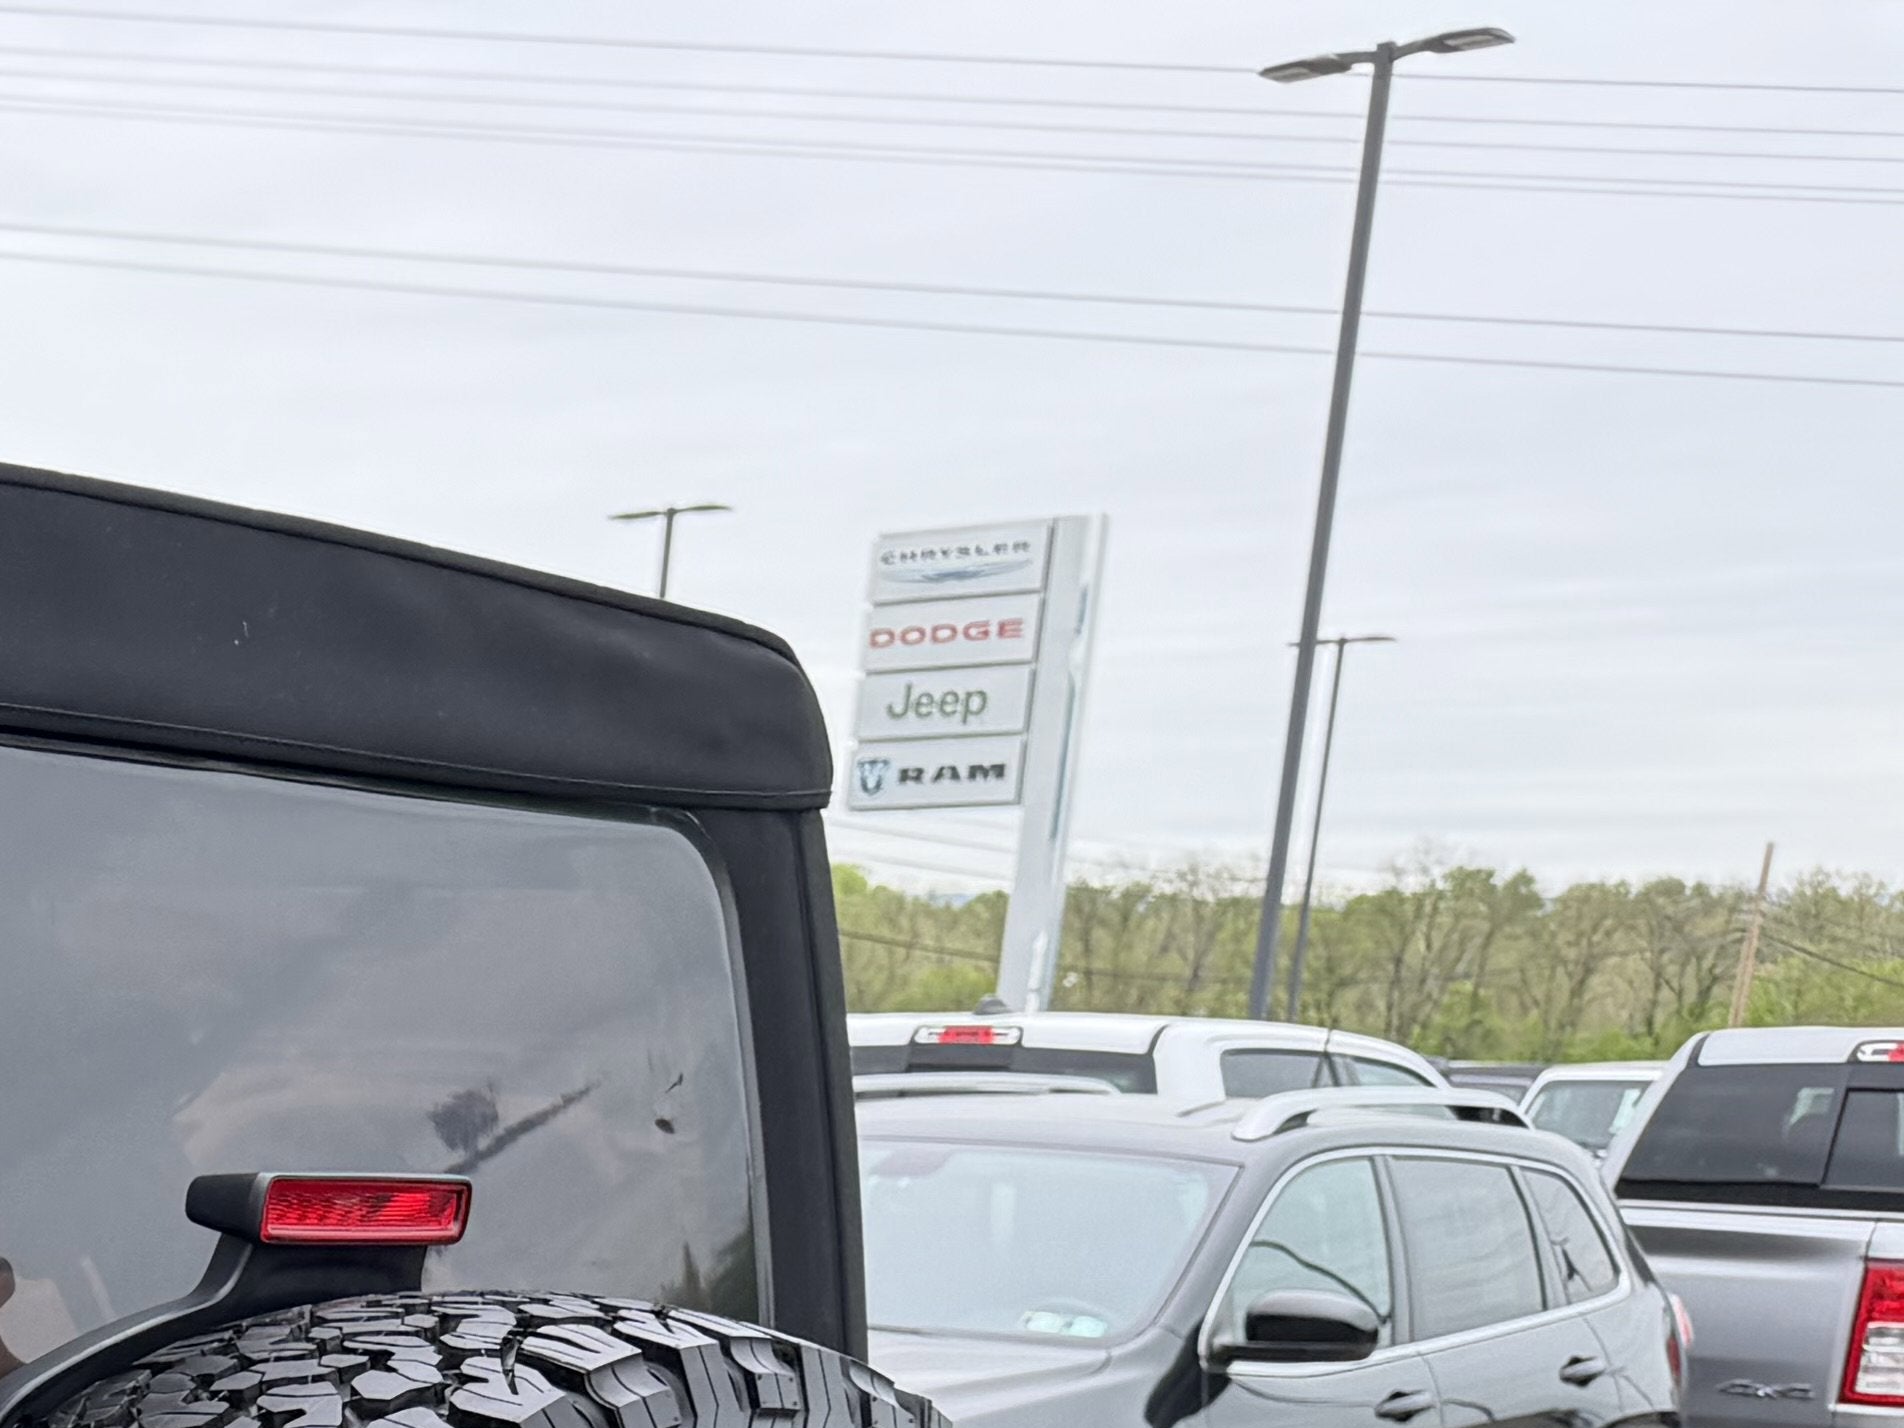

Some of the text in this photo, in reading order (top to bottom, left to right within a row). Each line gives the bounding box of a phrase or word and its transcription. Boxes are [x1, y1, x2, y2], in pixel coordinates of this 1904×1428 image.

[881, 540, 1032, 566] CHRYSLER
[869, 617, 1024, 649] DODGE
[886, 680, 988, 725] Jeep
[898, 762, 1007, 785] RAM
